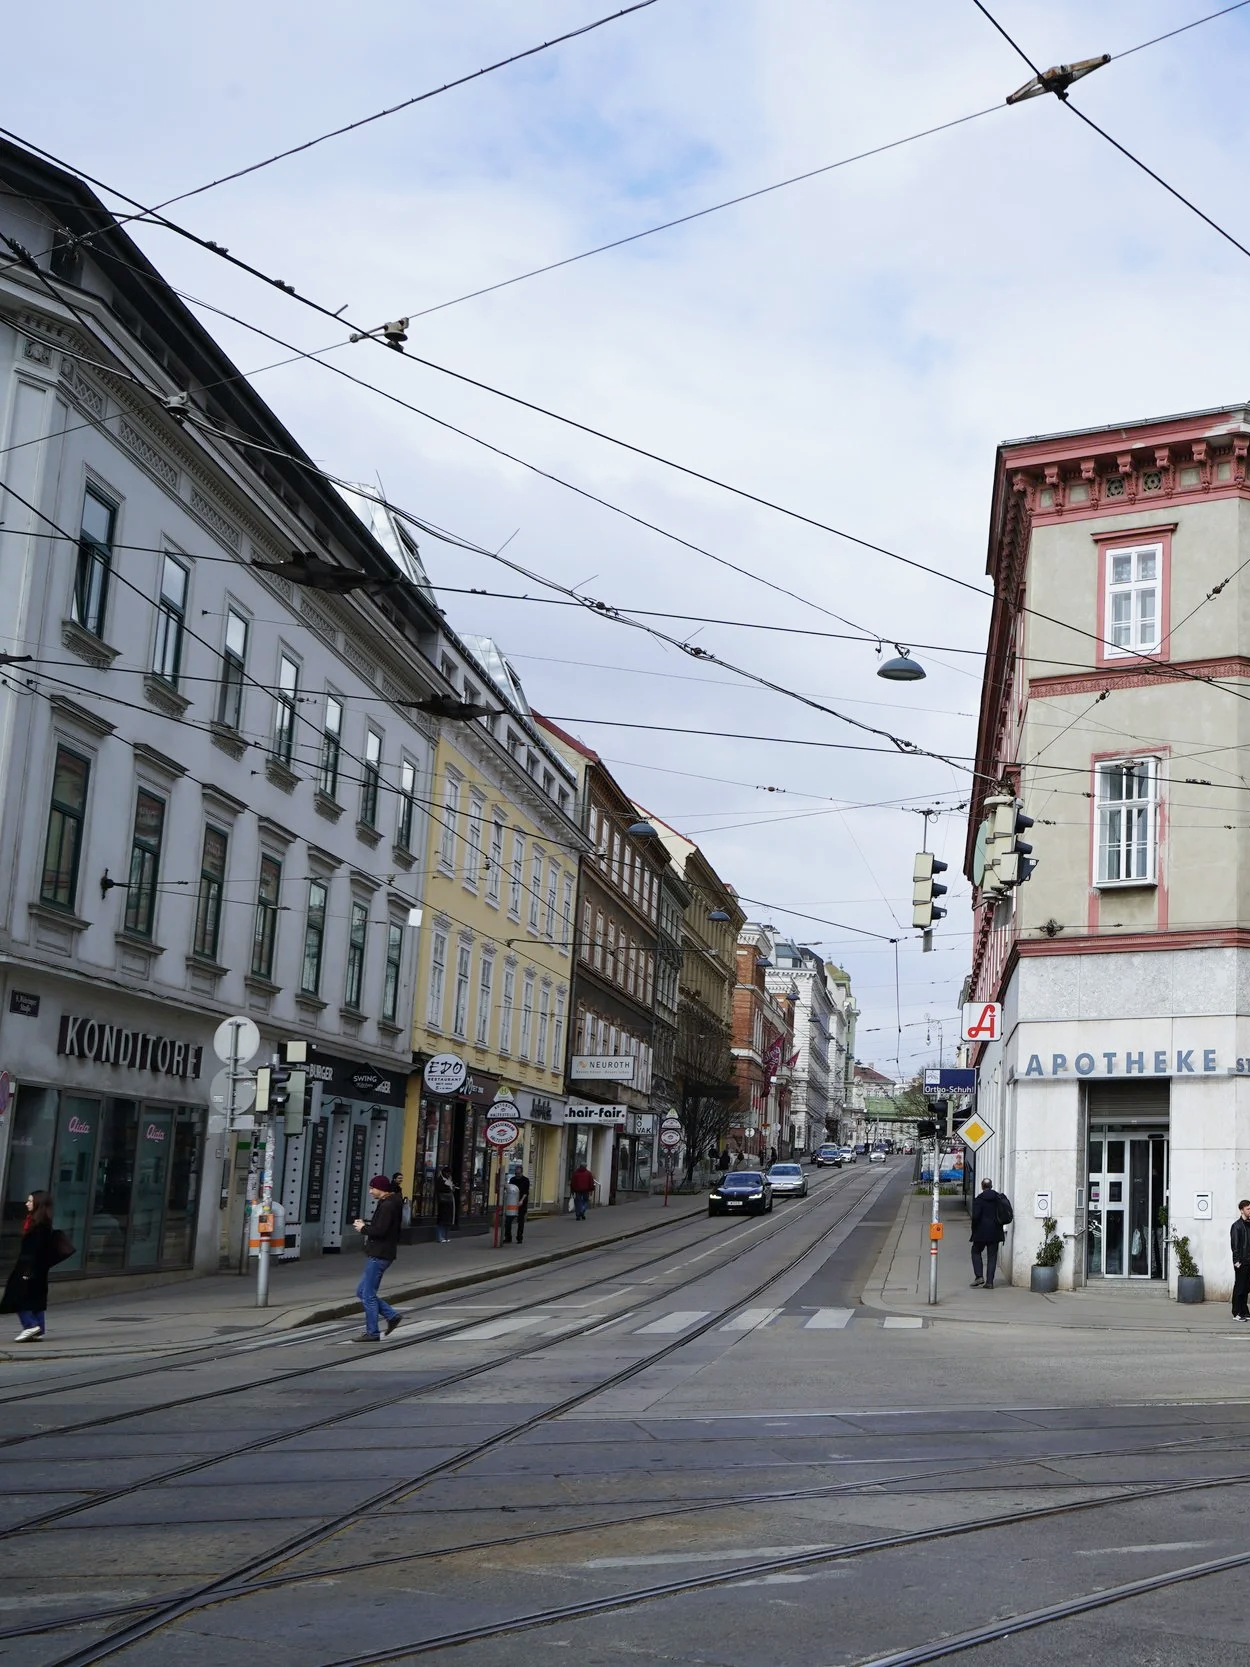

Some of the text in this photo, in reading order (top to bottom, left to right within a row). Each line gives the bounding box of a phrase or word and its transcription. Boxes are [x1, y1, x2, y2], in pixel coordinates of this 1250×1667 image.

[65, 1015, 204, 1079] KONDITOREI
[428, 1061, 463, 1074] EDO
[589, 1061, 630, 1069] NEUROTH
[1025, 1049, 1216, 1077] APOTHEKE
[309, 1064, 333, 1080] BURGER
[924, 1085, 974, 1094] Ortho-Schuh!
[68, 1116, 91, 1134] Aida
[146, 1124, 165, 1140] Aida
